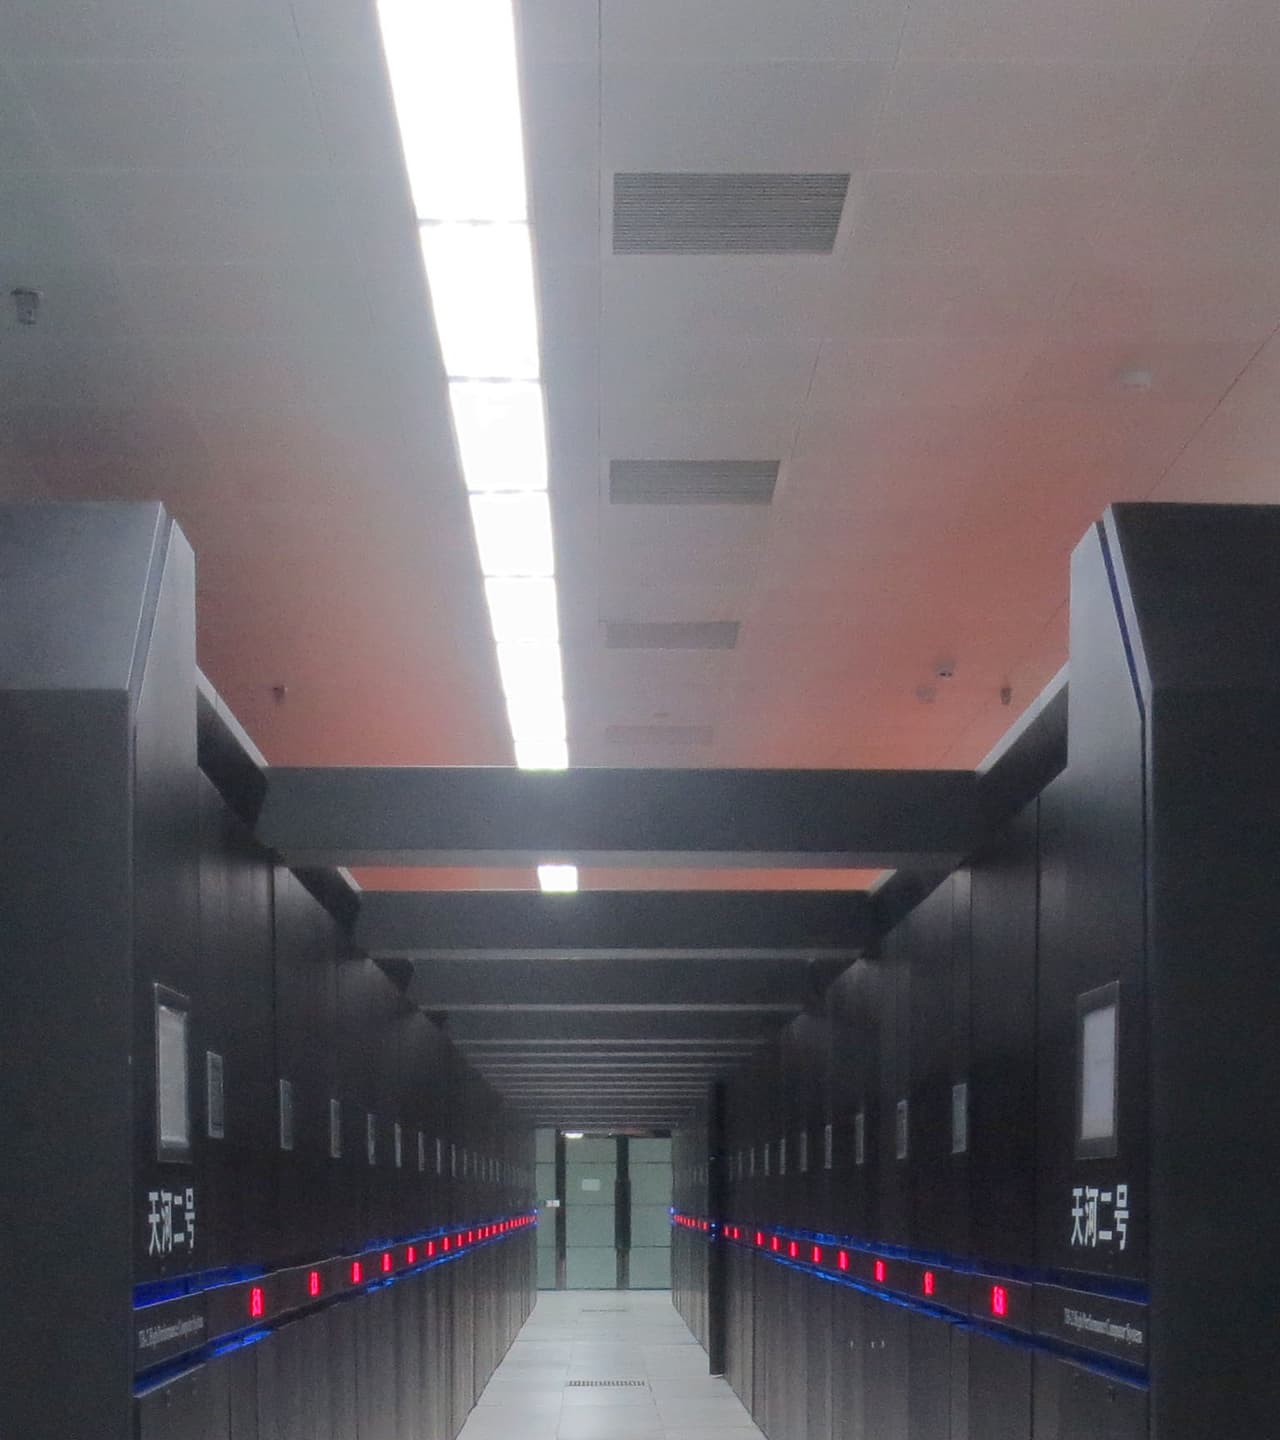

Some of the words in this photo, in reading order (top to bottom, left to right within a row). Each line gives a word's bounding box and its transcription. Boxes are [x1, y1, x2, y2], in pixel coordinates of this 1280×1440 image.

[148, 1188, 195, 1255] 天河二号
[1070, 1184, 1129, 1251] 天河二号
